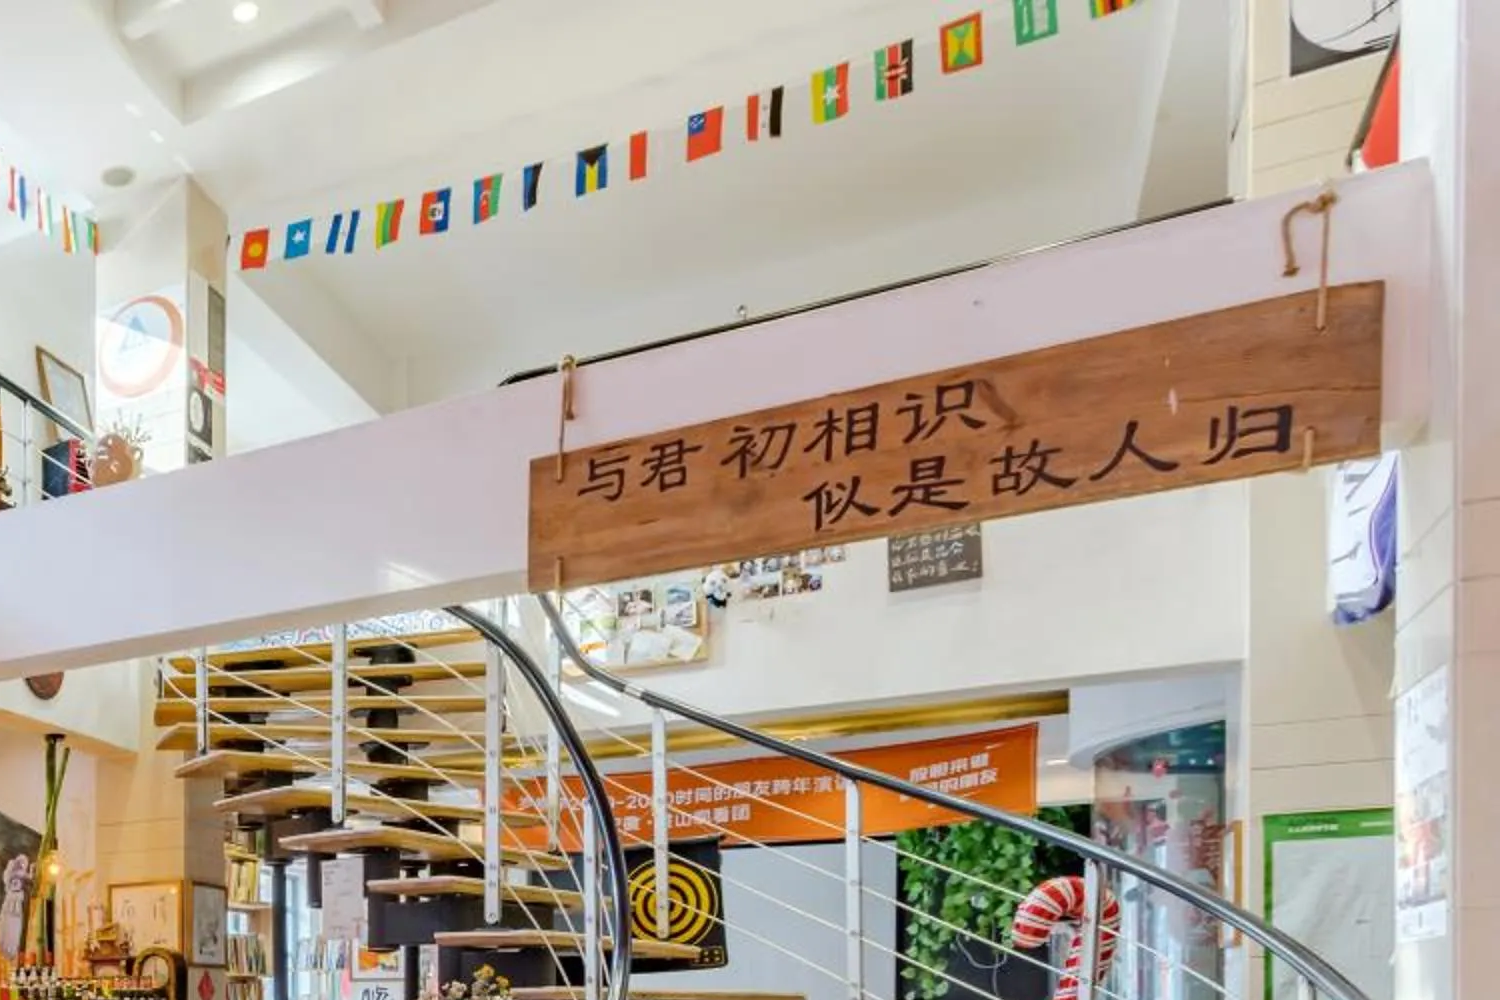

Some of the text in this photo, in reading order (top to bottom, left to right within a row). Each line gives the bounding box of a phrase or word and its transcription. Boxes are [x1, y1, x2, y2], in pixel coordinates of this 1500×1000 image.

[577, 379, 987, 501] 与君初相识
[803, 403, 1295, 532] 似是故人归
